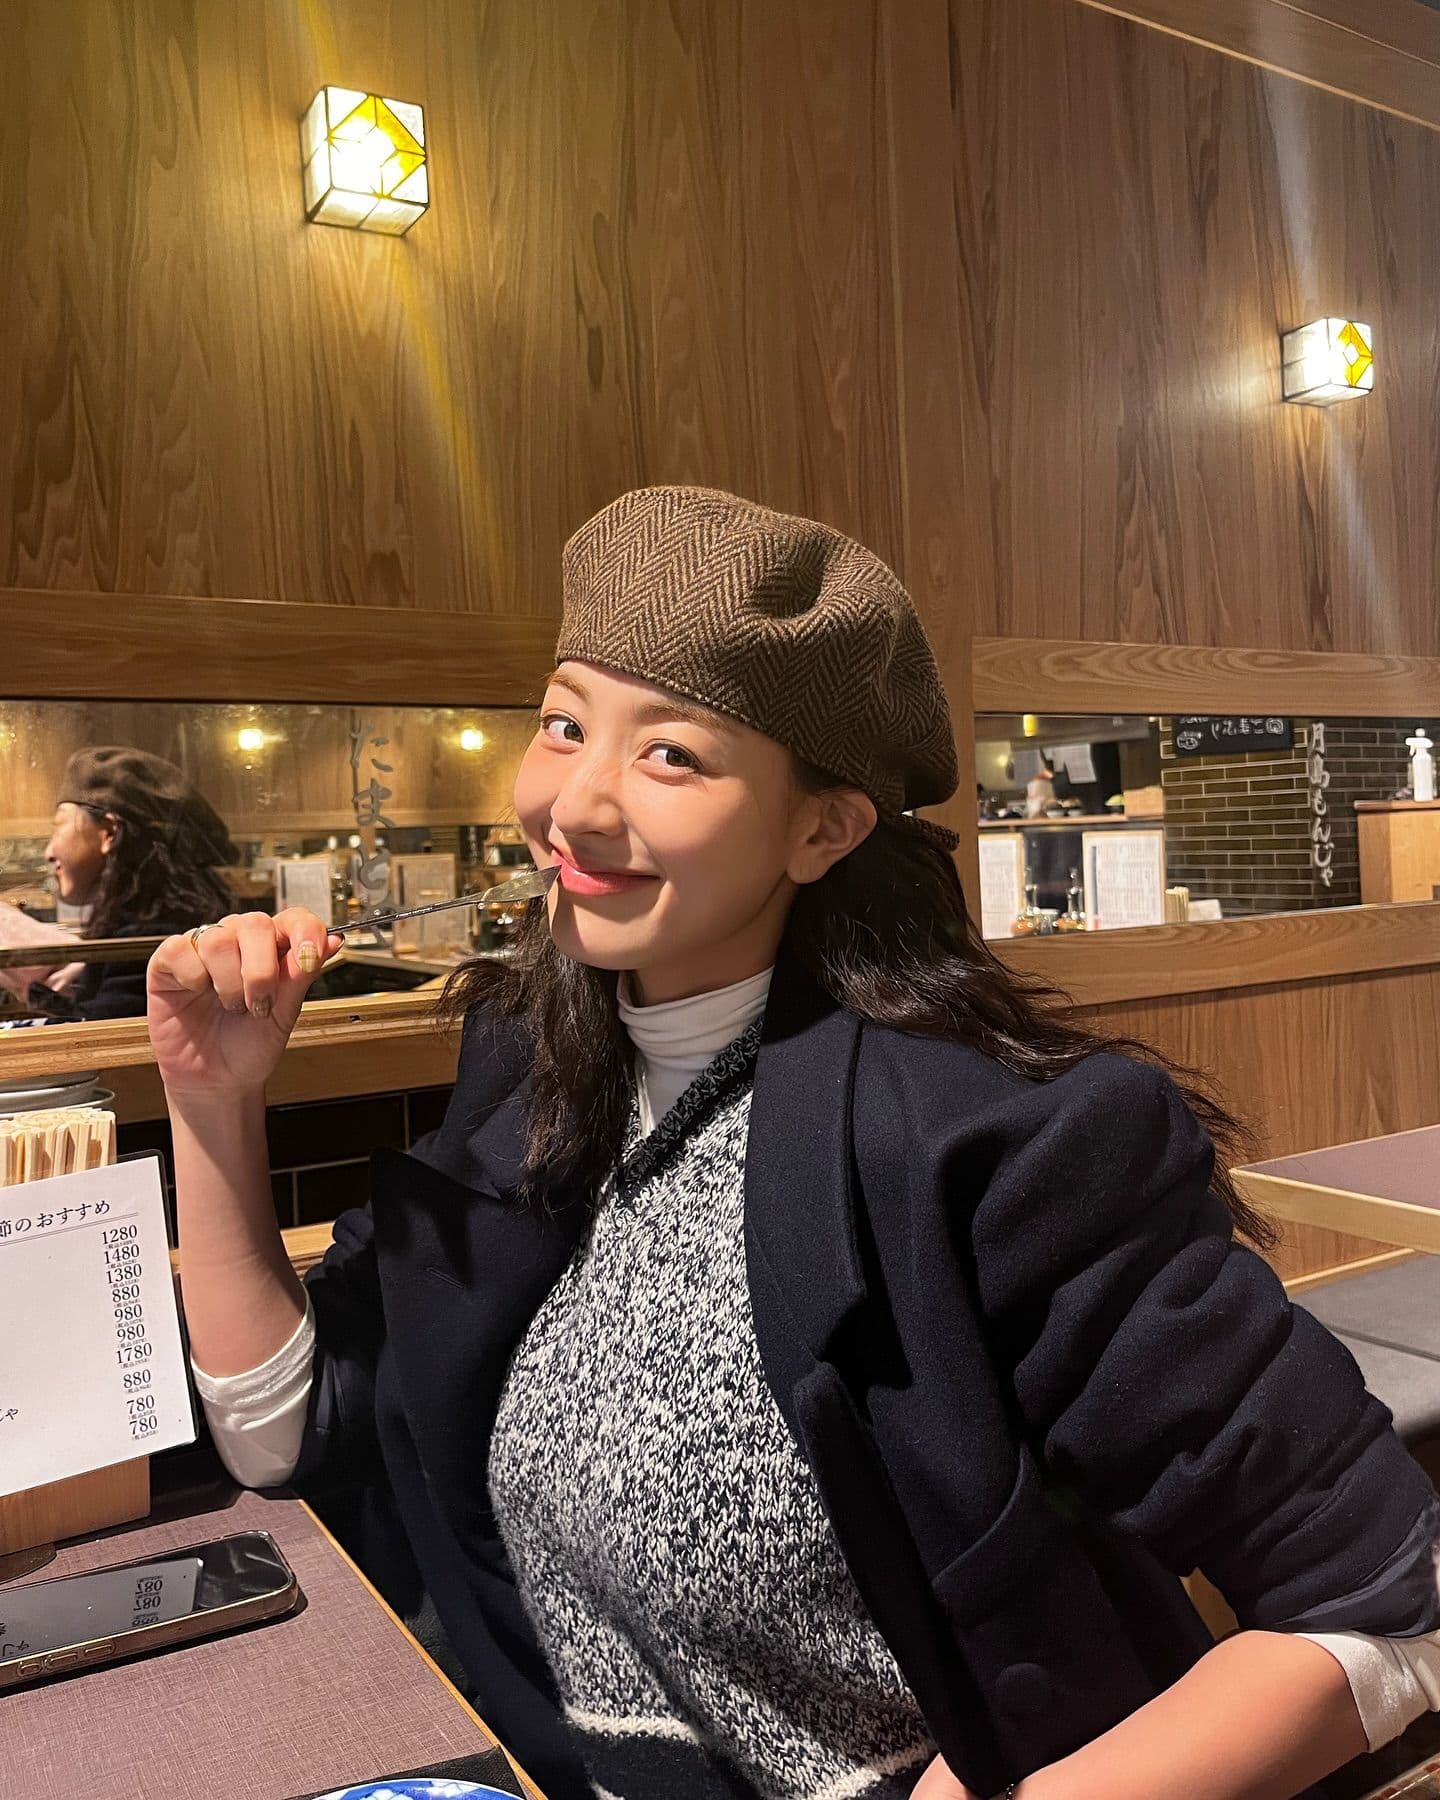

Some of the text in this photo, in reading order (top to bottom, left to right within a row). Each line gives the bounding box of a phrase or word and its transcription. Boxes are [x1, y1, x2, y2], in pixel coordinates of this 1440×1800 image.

[102, 1224, 138, 1245] 1280
[104, 1243, 140, 1265] 1480
[106, 1263, 142, 1285] 1380
[112, 1284, 140, 1303] 880
[114, 1304, 143, 1323] 980
[117, 1323, 146, 1343] 980
[117, 1342, 152, 1364] 1780
[123, 1369, 152, 1389] 880
[126, 1394, 155, 1415] 780
[129, 1415, 158, 1436] 780
